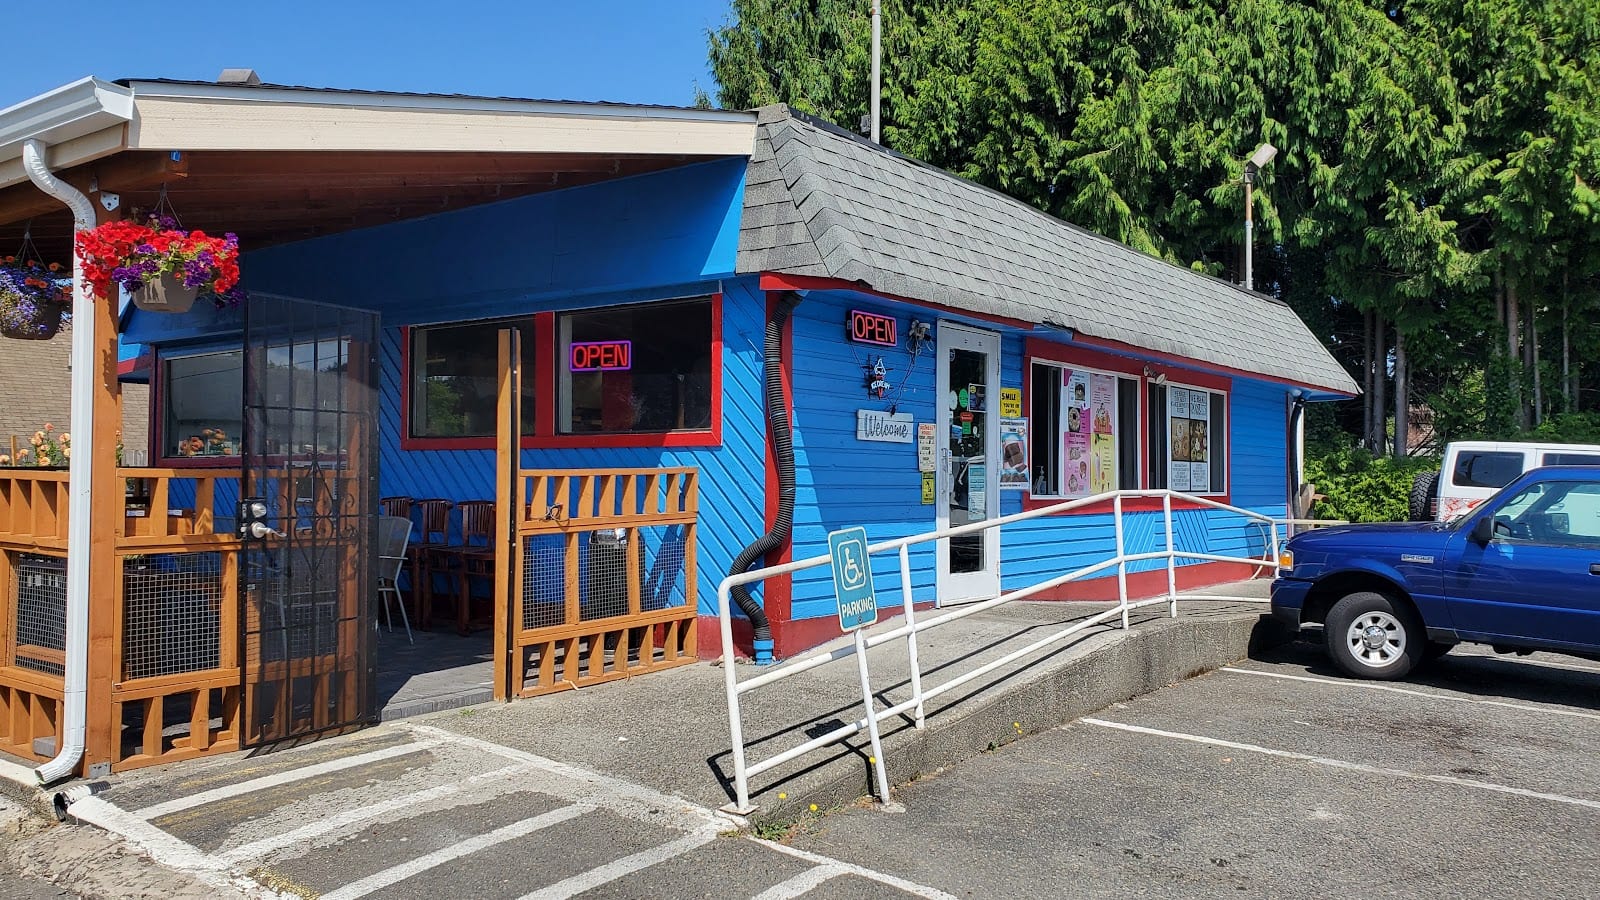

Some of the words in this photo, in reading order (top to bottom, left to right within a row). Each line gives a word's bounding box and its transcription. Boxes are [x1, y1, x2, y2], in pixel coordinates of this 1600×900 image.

[855, 314, 895, 343] OPEN
[573, 344, 628, 368] OPEN
[864, 414, 909, 438] Welcome
[841, 597, 874, 618] PARKING
